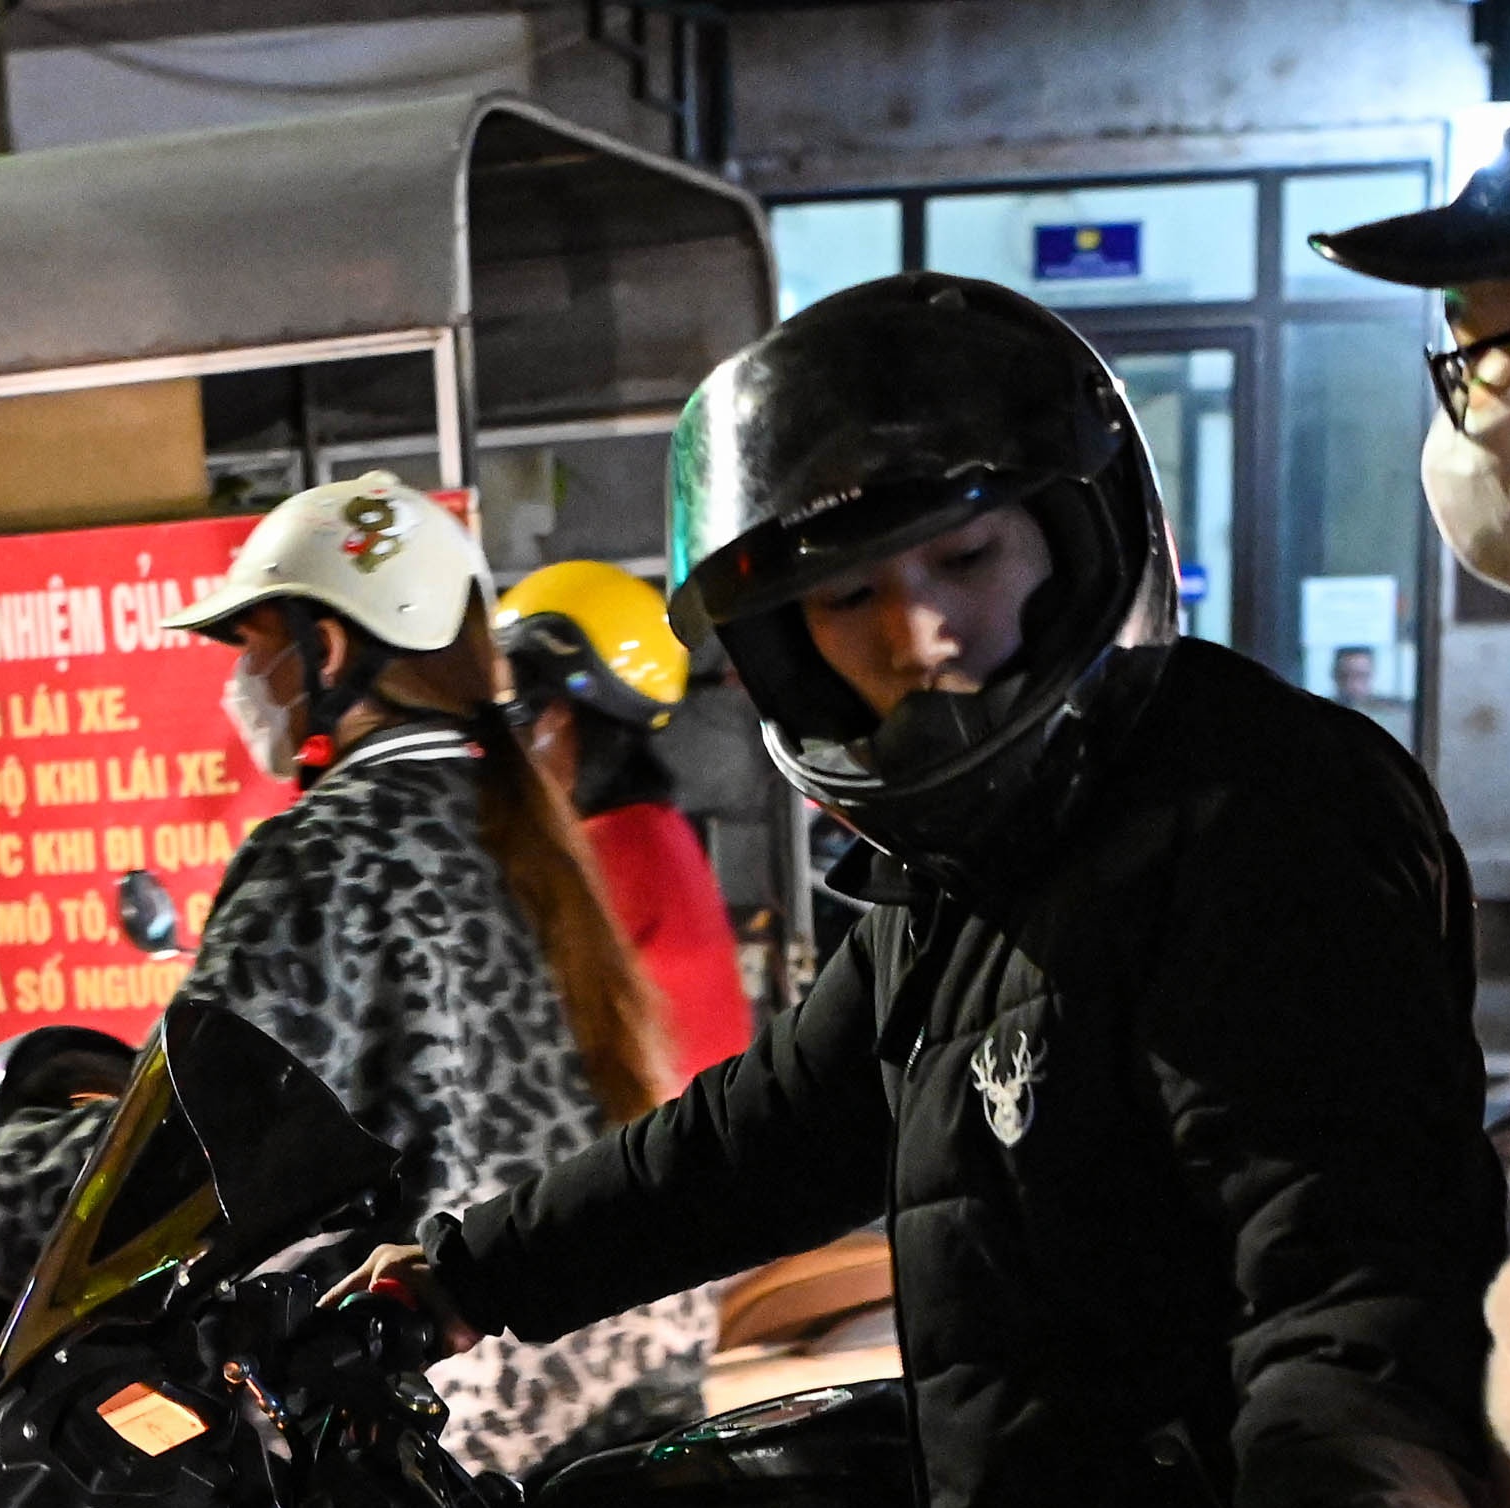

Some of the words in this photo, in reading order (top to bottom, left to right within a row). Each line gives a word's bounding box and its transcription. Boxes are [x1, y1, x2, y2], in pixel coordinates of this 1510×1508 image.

[110, 552, 189, 653] CỦA
[9, 683, 70, 739] LÁI
[77, 685, 140, 734] XE.
[34, 759, 100, 806] KHI
[106, 746, 168, 801] LÁI
[177, 750, 240, 798] XE.
[31, 829, 97, 876] KHI
[154, 820, 233, 874] QUA
[59, 889, 120, 947] TÔ,
[15, 952, 65, 1014] SỐ
